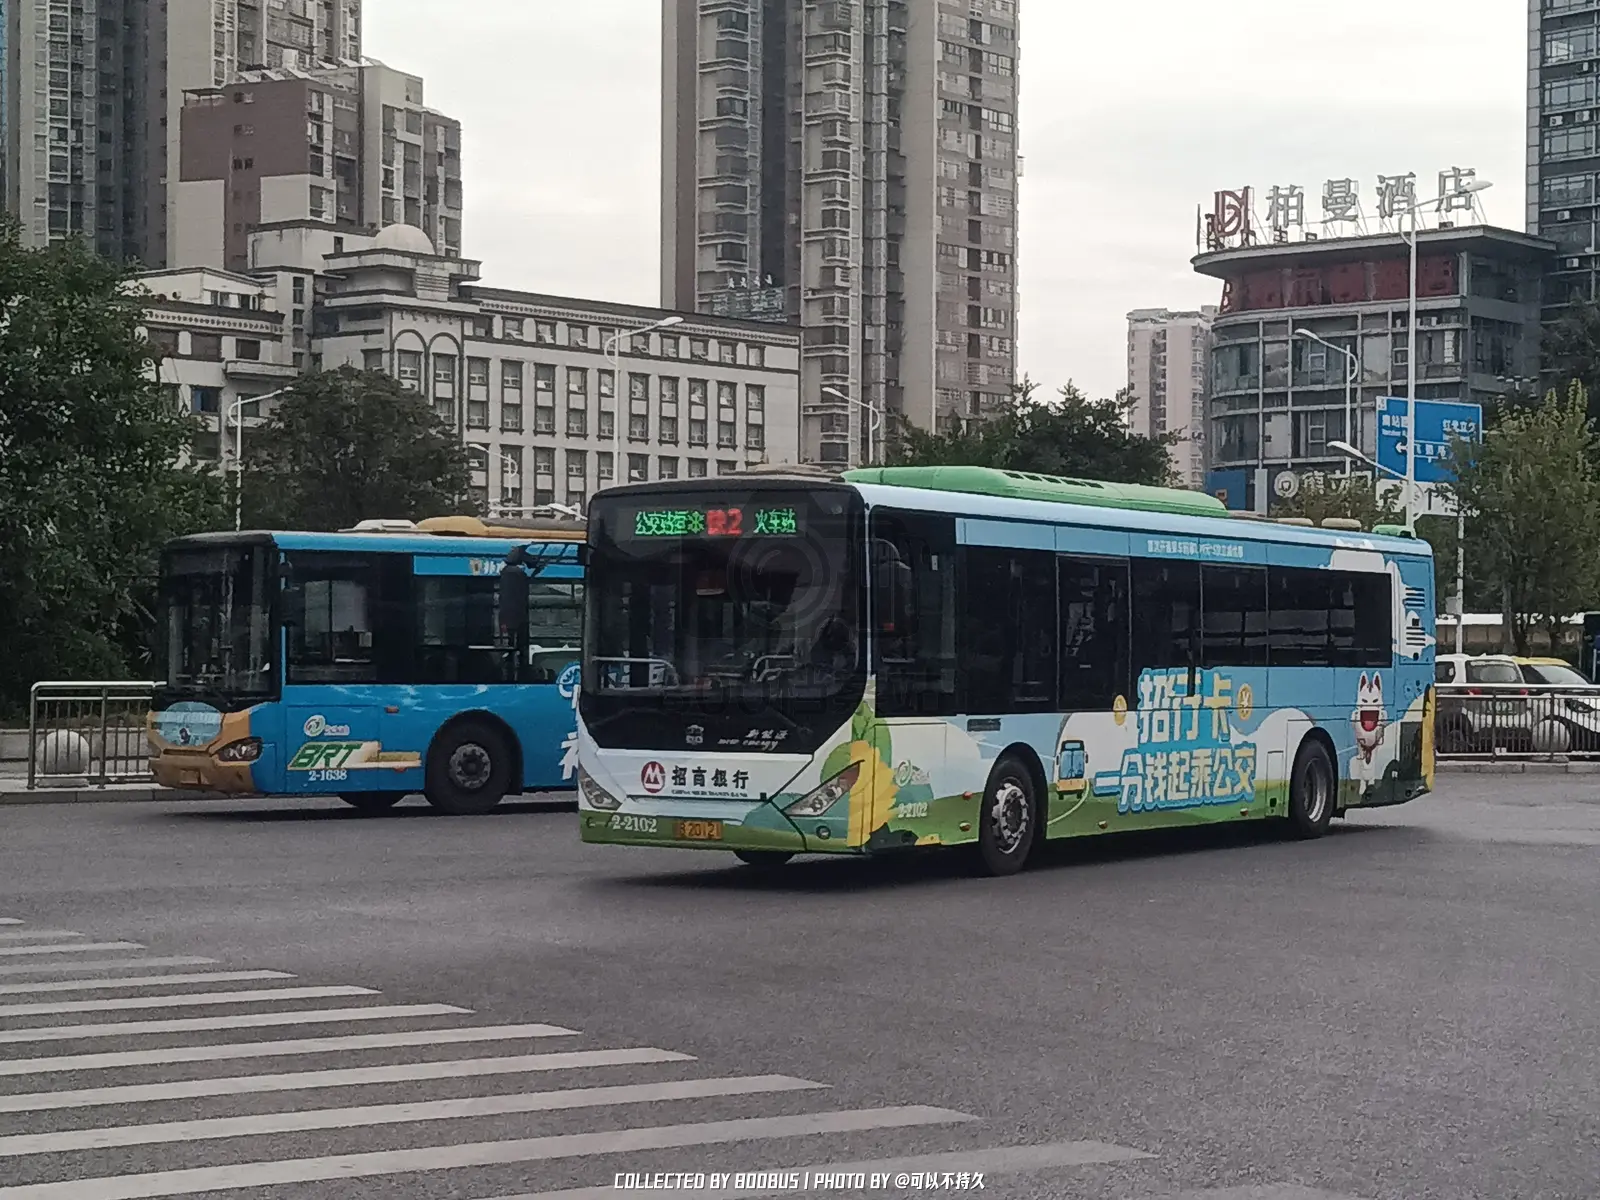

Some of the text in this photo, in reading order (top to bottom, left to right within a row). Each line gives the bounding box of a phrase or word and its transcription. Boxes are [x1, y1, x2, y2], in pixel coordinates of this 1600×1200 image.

[1265, 166, 1476, 229] 柏曼酒店
[1140, 672, 1233, 744] 招行卡
[290, 743, 363, 768] BRT
[308, 769, 348, 781] 2-1638
[671, 765, 750, 790] 招商银行
[1095, 747, 1256, 806] 一分钱起乘公交
[611, 814, 658, 833] 2-2102
